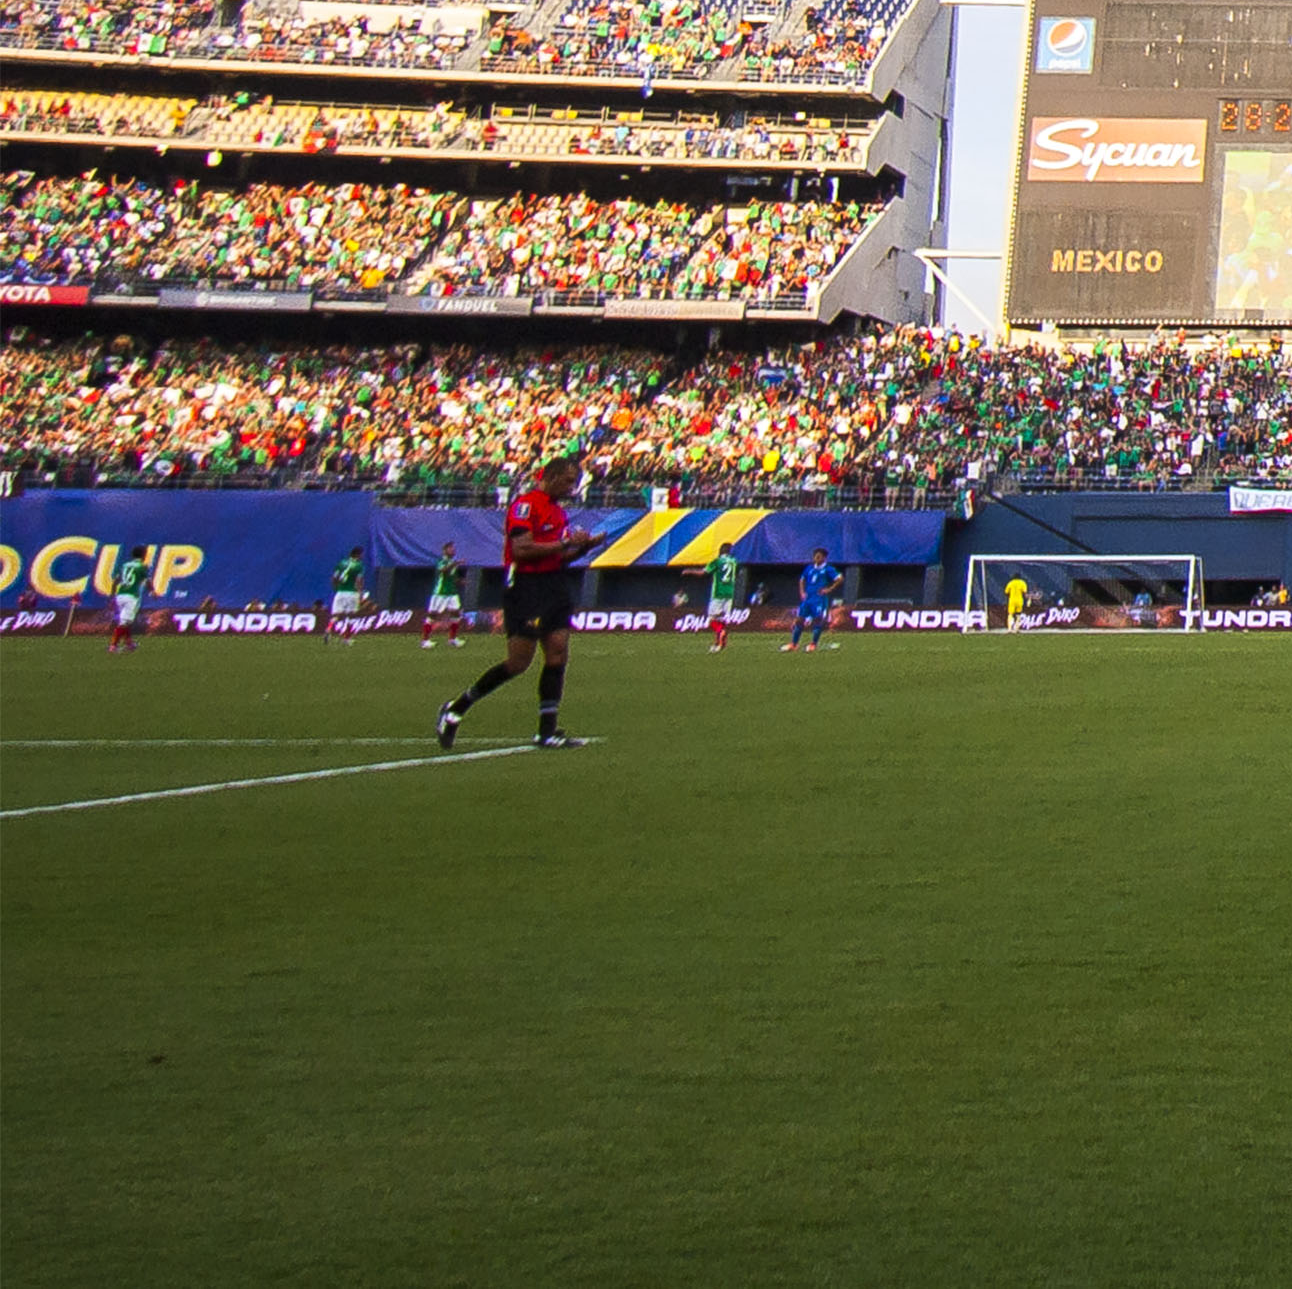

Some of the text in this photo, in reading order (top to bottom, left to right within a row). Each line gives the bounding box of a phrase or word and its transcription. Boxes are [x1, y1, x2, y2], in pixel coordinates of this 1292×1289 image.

[1032, 119, 1201, 181] Sycuan
[1051, 249, 1164, 272] MEXICO
[436, 298, 498, 312] FANDUEL
[30, 536, 204, 598] CUP
[172, 613, 316, 633] TUNDRA
[851, 610, 986, 629] TUNDRA
[1045, 607, 1080, 626] DURO
